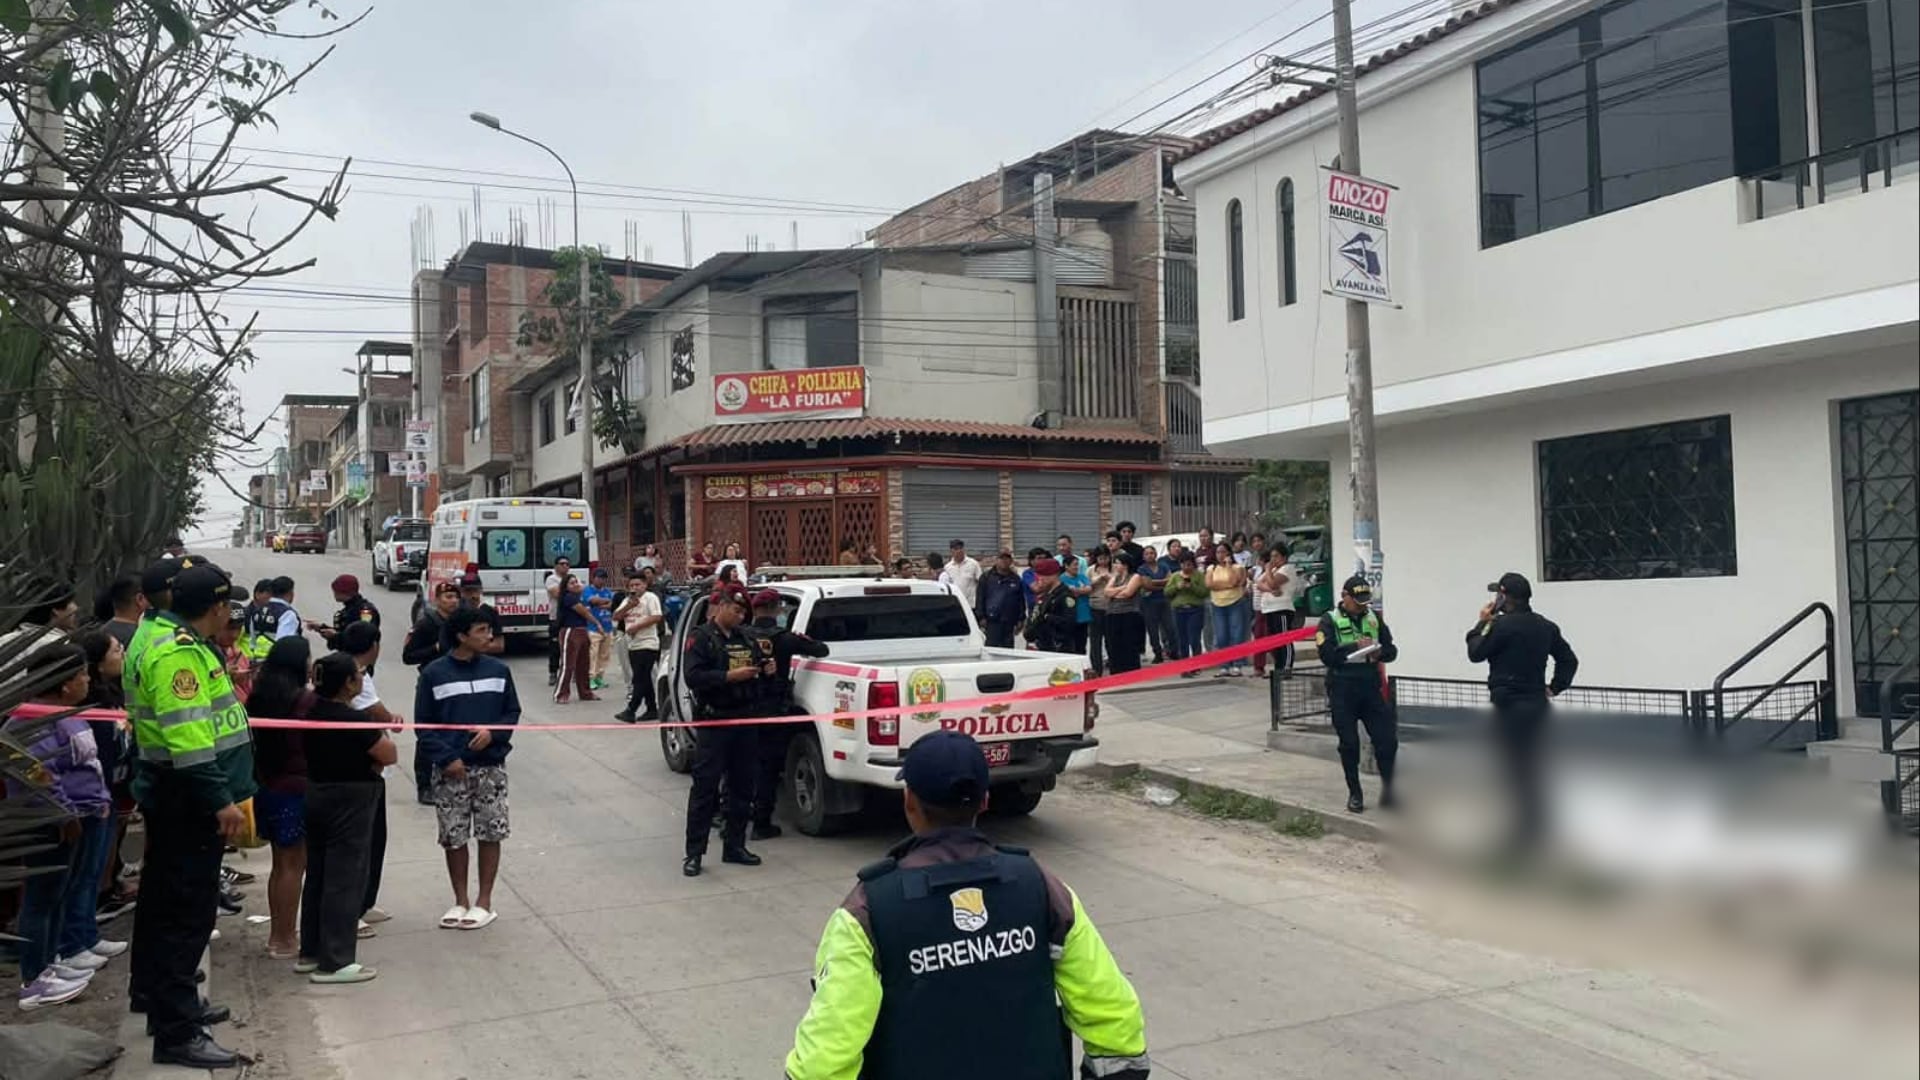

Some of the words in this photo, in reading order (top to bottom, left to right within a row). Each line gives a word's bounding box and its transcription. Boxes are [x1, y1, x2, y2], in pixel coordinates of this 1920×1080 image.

[1332, 178, 1386, 211] MOZO
[1329, 204, 1366, 222] MARCA
[1336, 279, 1369, 291] AVANZA
[749, 375, 788, 395] CHIFA
[706, 475, 745, 486] CHIFA
[939, 712, 1050, 738] POLICIA
[909, 926, 1036, 974] SERENAZGO
